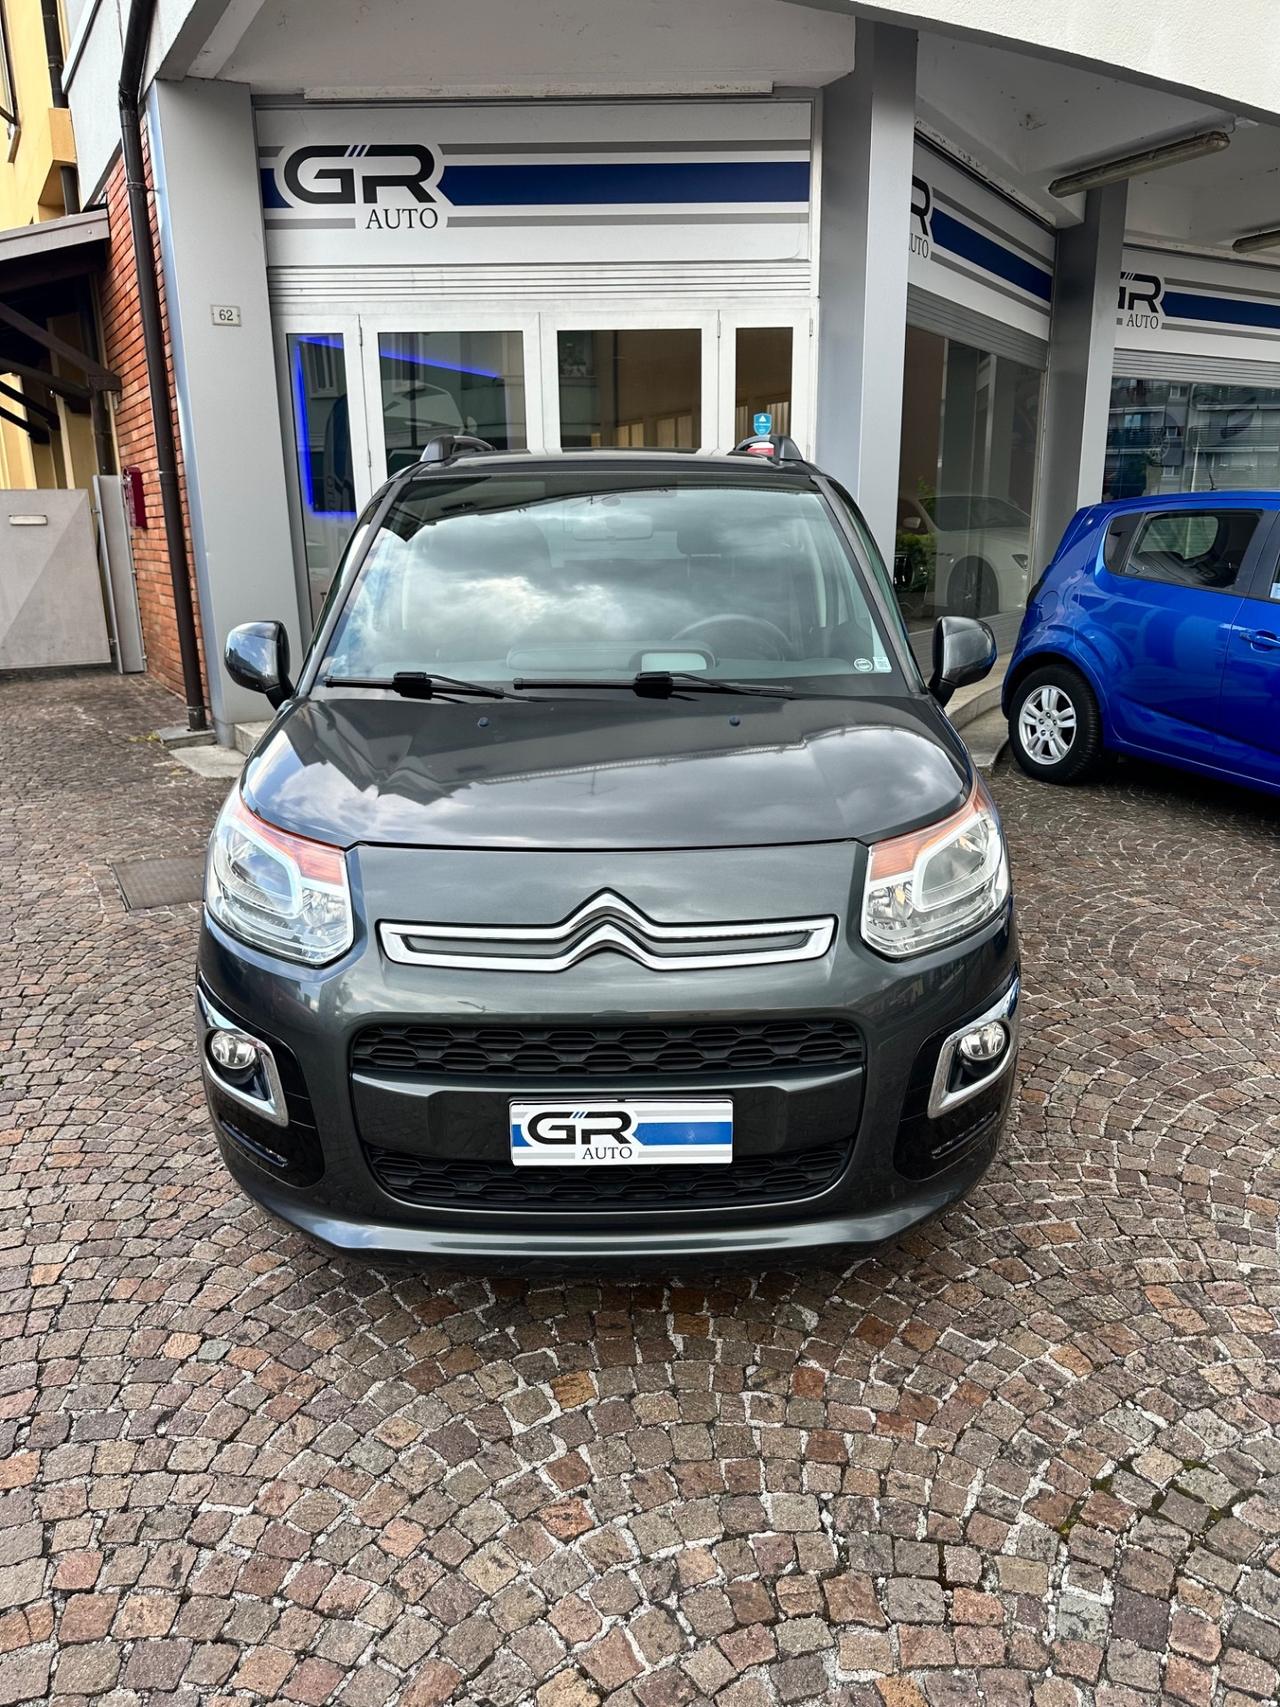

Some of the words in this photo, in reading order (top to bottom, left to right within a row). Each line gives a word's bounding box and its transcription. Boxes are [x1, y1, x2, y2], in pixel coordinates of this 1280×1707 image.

[284, 144, 437, 204] GR
[911, 174, 931, 237] R
[365, 207, 439, 230] AUTO
[908, 232, 929, 258] UTO
[219, 309, 234, 321] 62
[1126, 313, 1159, 329] AUTO
[527, 1111, 632, 1145] GR
[582, 1147, 633, 1160] AUTO
